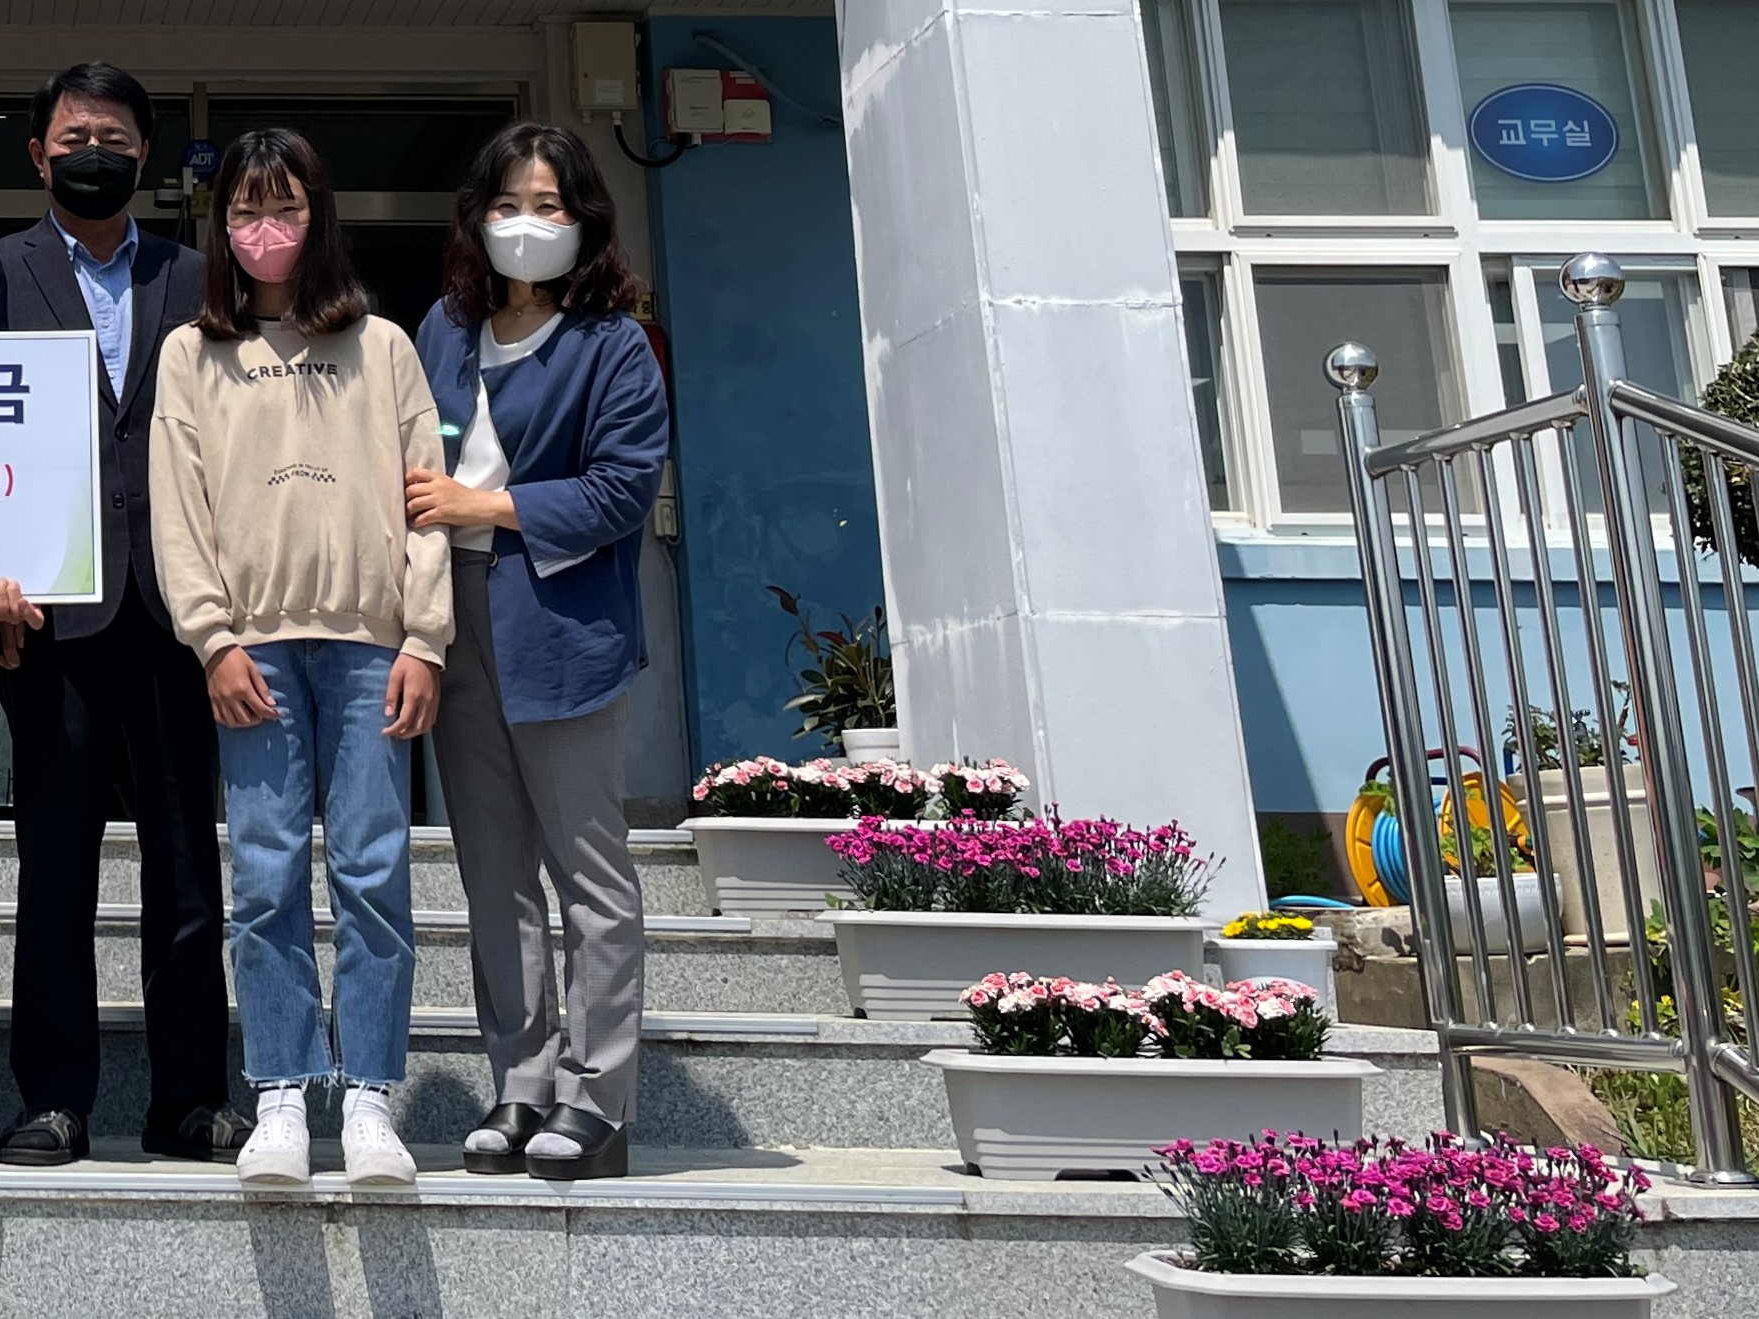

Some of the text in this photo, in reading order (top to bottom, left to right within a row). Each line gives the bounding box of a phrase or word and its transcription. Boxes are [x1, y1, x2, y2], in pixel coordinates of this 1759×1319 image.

[1498, 118, 1592, 147] 교무실
[188, 152, 215, 166] ADT
[247, 362, 338, 380] CREATIVE
